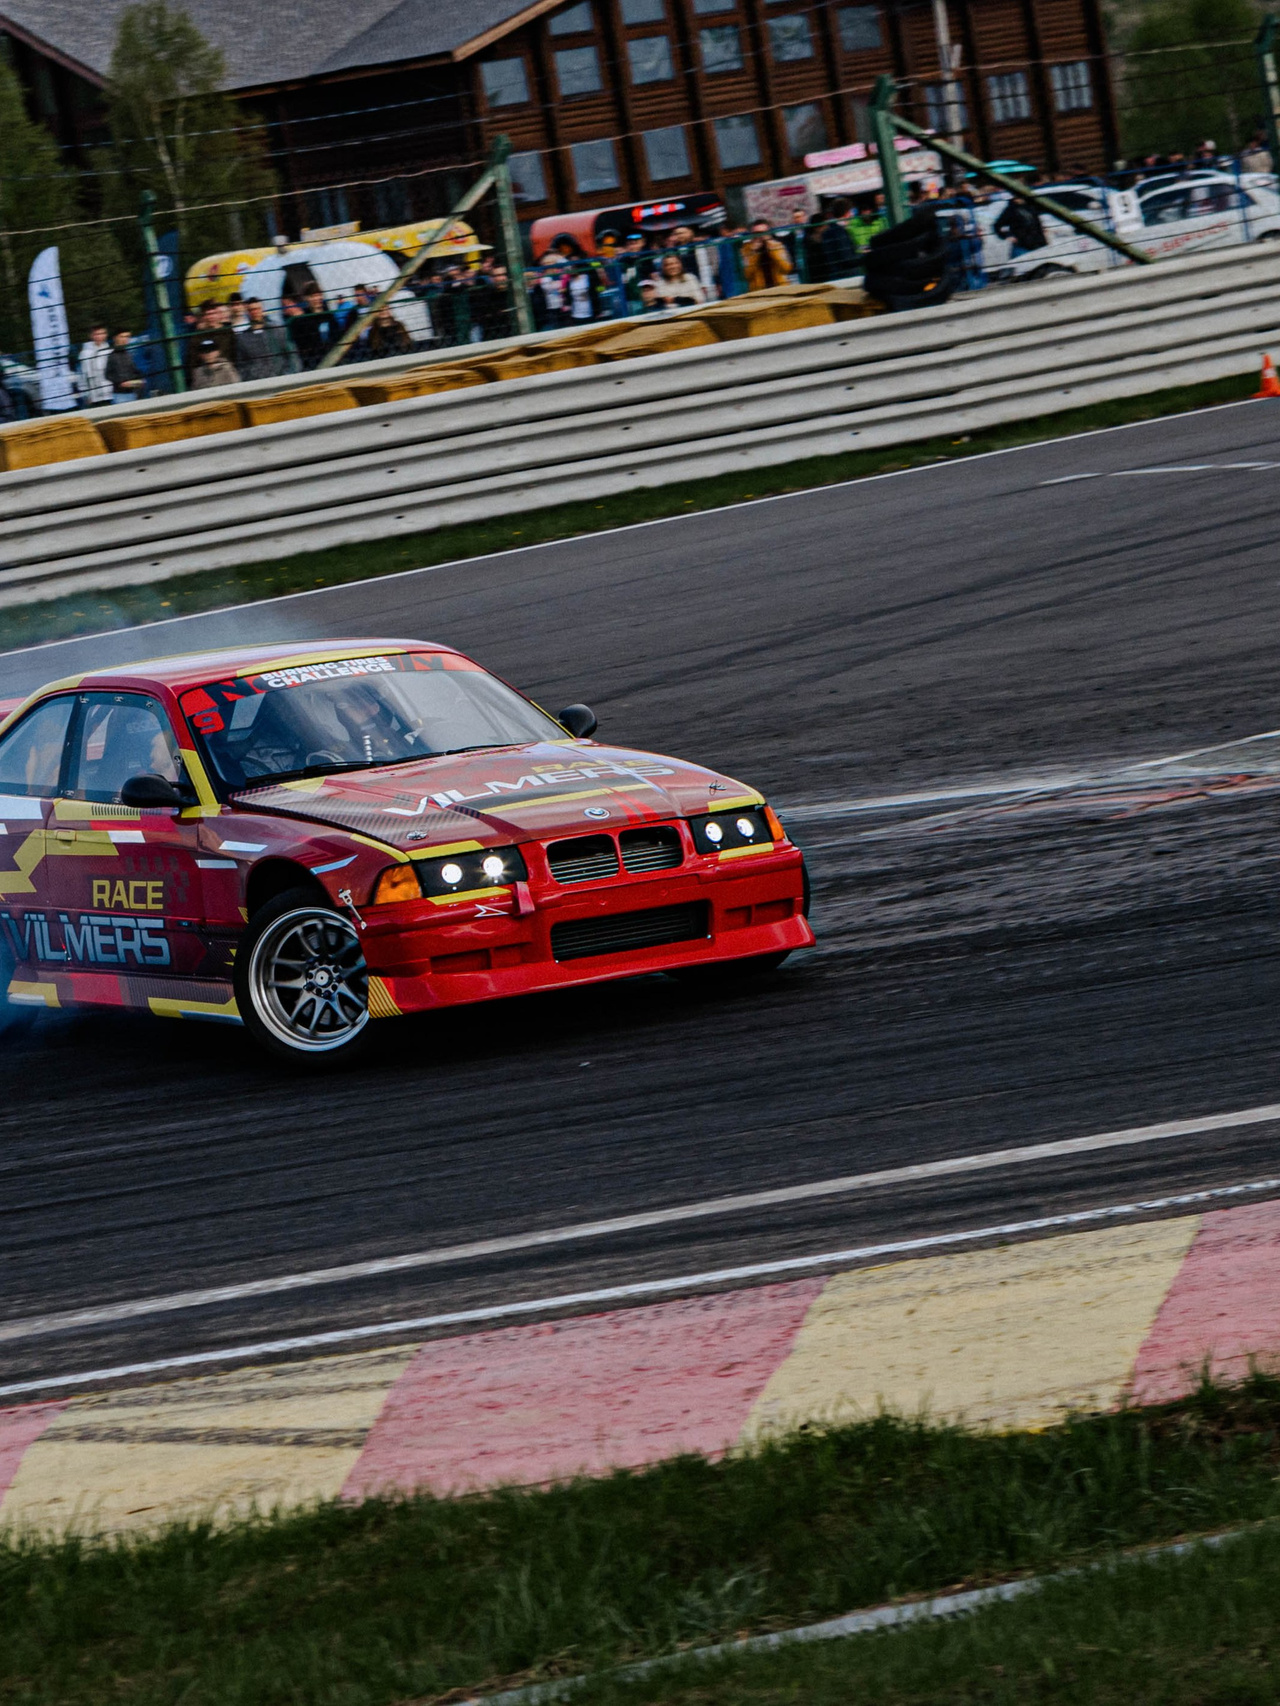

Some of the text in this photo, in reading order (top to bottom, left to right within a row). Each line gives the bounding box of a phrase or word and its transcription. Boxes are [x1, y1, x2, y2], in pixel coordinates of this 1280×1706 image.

[259, 662, 338, 681] BURNING
[338, 656, 389, 669] TIRES
[267, 663, 396, 688] CHALLENGE
[193, 711, 225, 734] 9
[382, 764, 675, 817] VILMERS
[92, 879, 164, 910] RACE
[0, 912, 171, 965] VILMERS
